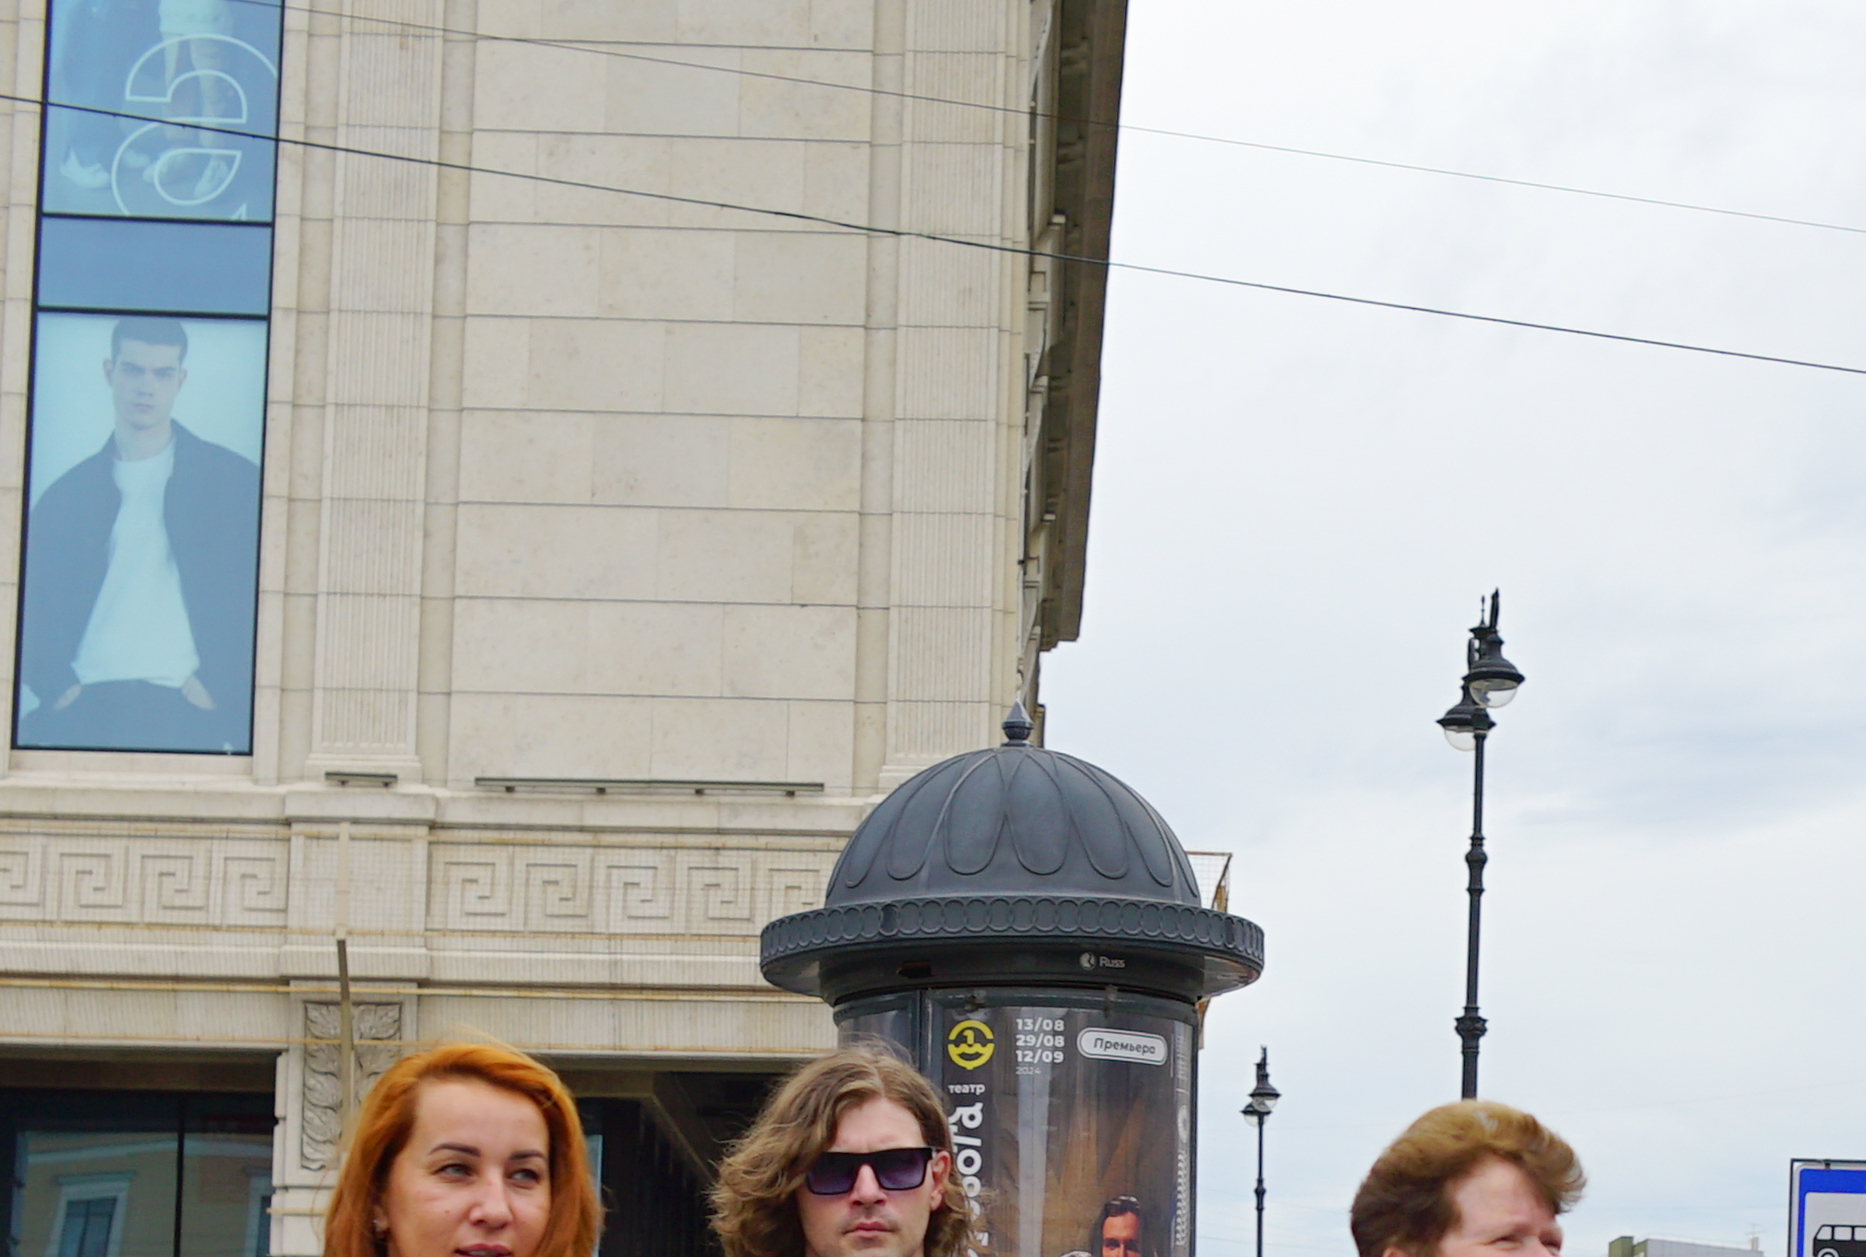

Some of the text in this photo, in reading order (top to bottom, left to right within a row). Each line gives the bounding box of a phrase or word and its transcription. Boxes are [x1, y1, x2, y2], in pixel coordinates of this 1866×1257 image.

[1015, 1018, 1065, 1032] 13/08
[1015, 1034, 1065, 1048] 29/08
[1093, 1037, 1157, 1056] Премьера
[1015, 1050, 1064, 1064] 12/09
[1015, 1066, 1042, 1076] 2024
[947, 1083, 986, 1096] театр
